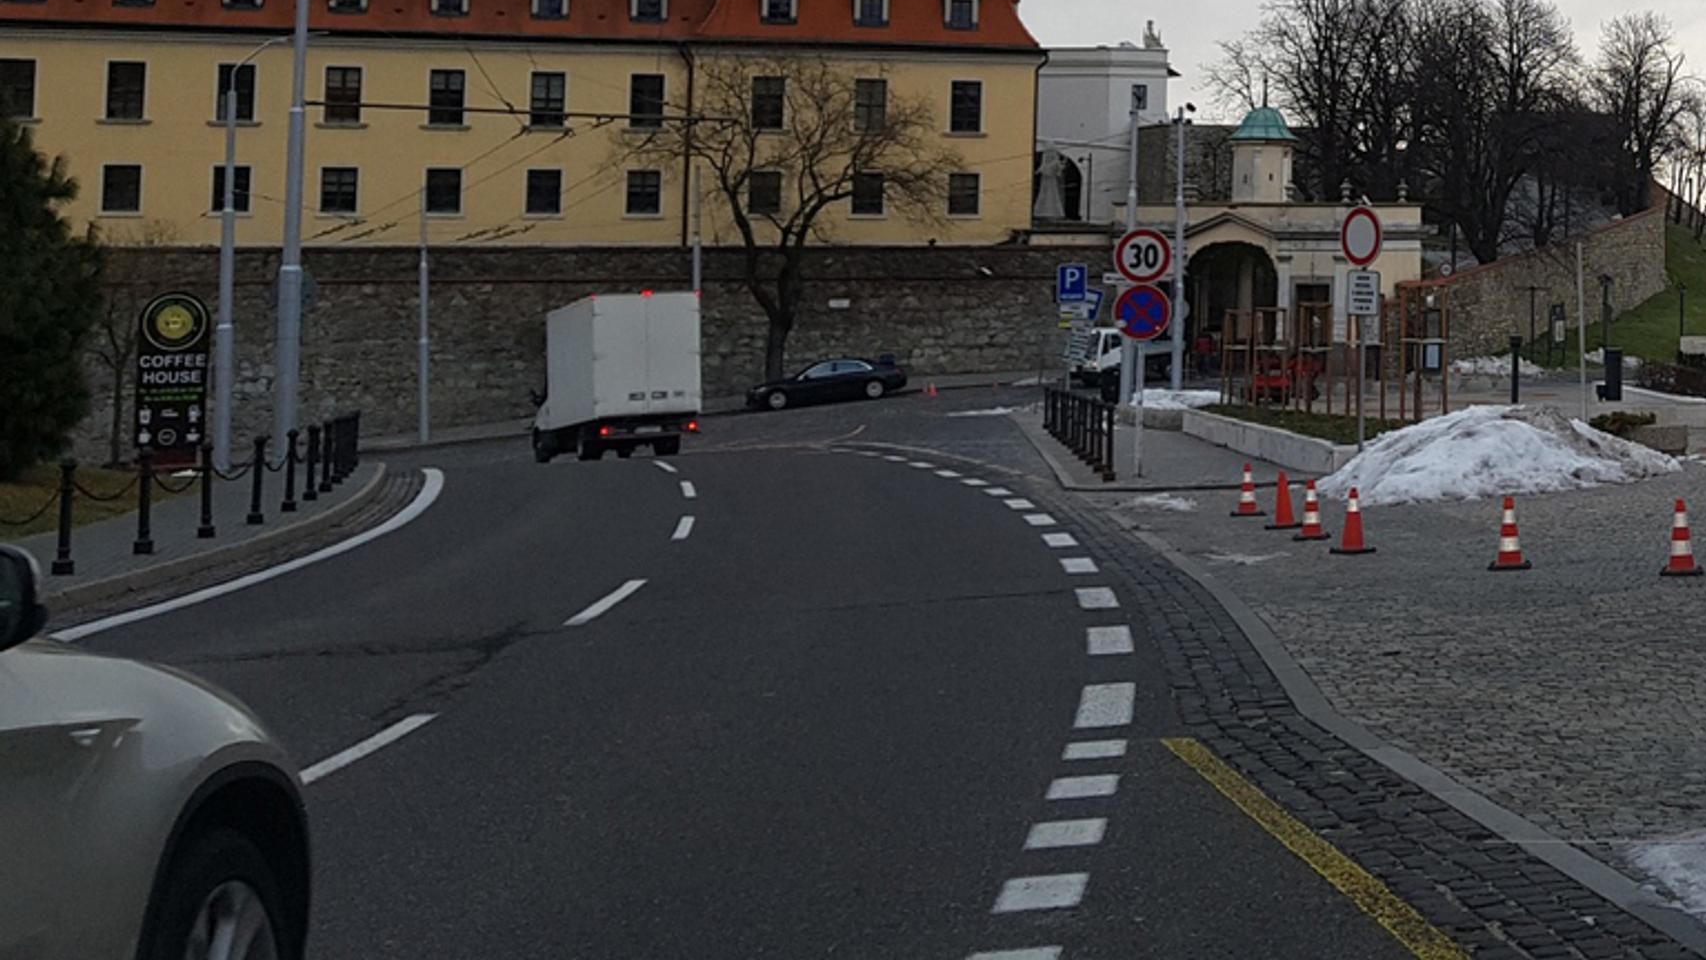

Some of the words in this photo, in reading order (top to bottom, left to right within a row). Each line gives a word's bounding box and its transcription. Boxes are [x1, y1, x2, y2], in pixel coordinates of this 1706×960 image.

[1129, 244, 1159, 269] 30
[1066, 269, 1080, 290] P
[140, 354, 206, 368] COFFEE
[142, 370, 202, 384] HOUSE
